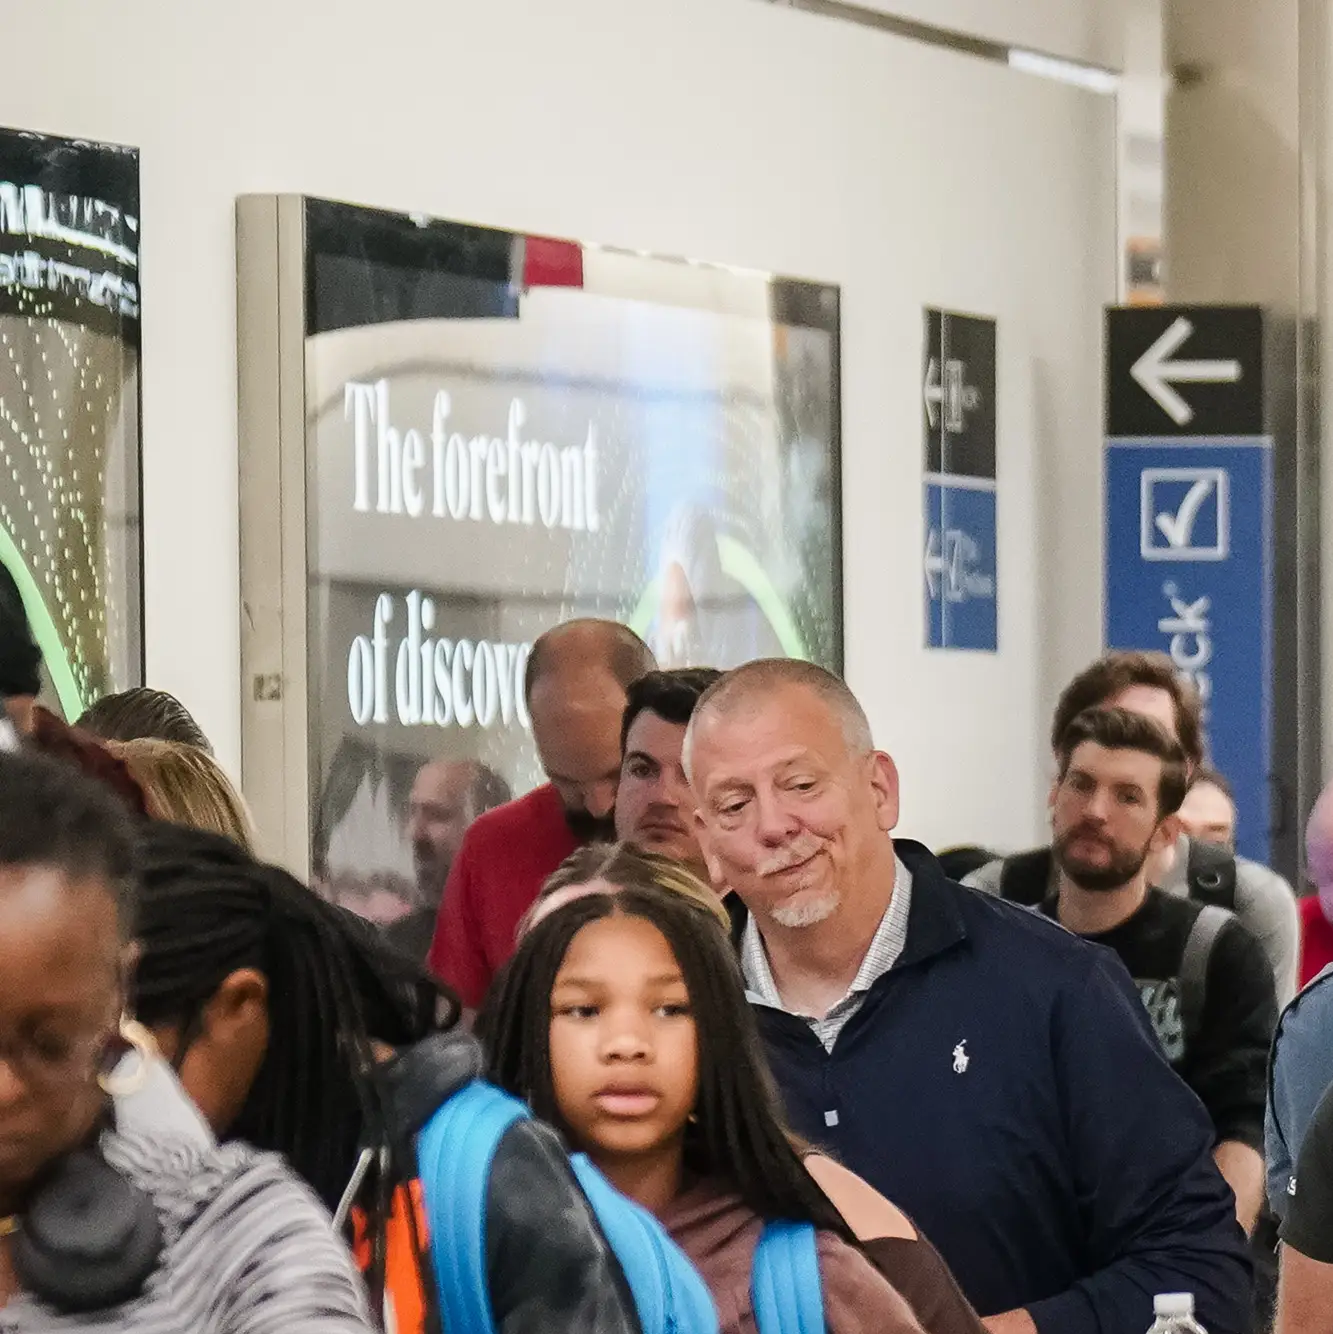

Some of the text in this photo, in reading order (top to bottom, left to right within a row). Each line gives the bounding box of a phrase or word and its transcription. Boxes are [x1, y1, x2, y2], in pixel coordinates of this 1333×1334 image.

[344, 378, 600, 533] The forefront
[347, 589, 534, 730] of discove
